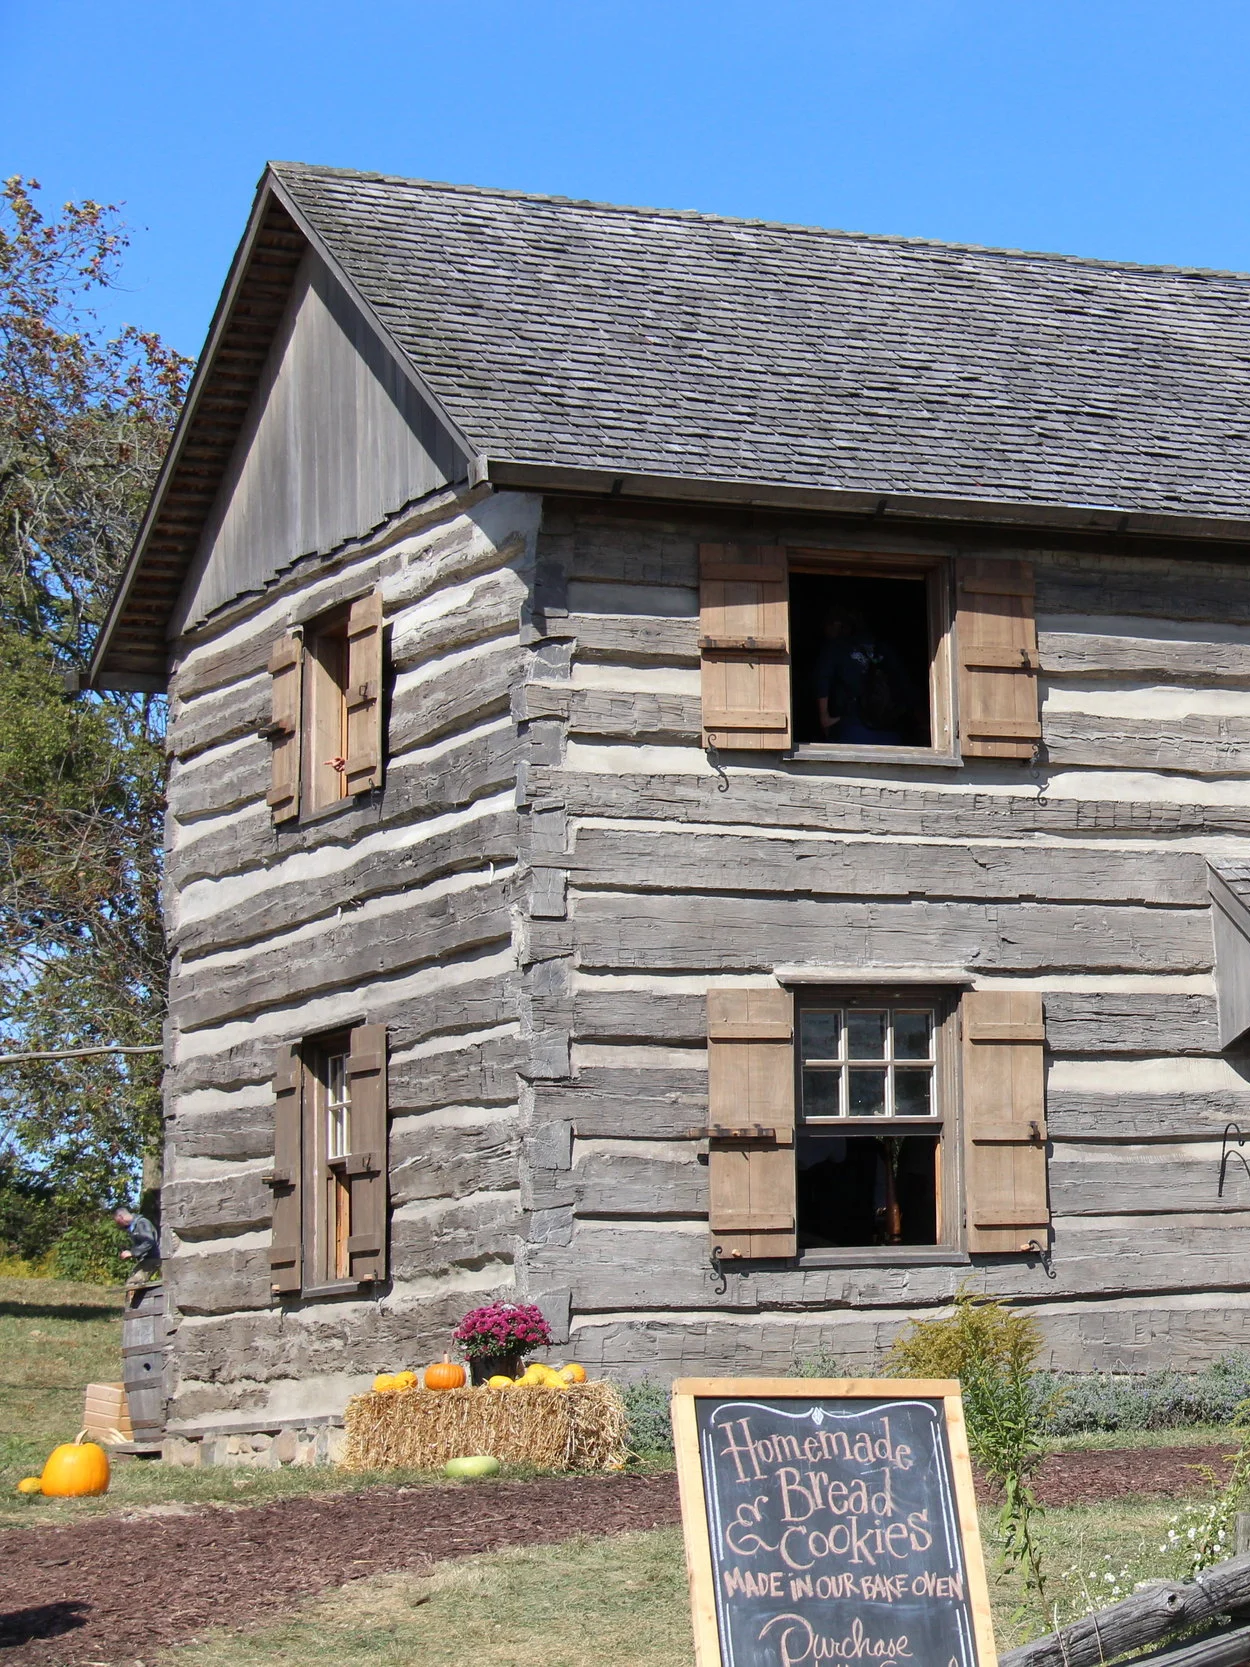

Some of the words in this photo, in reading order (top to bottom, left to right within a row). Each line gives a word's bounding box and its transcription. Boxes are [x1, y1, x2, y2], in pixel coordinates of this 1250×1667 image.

[718, 1416, 912, 1483] Homemade
[776, 1467, 893, 1522] Bread
[725, 1495, 779, 1556] &
[780, 1509, 933, 1570] Cookies
[724, 1567, 784, 1598] MADE
[816, 1572, 860, 1599] OUR
[860, 1573, 908, 1602] BAKE
[912, 1571, 964, 1601] OVEN
[759, 1613, 913, 1667] Purchase
